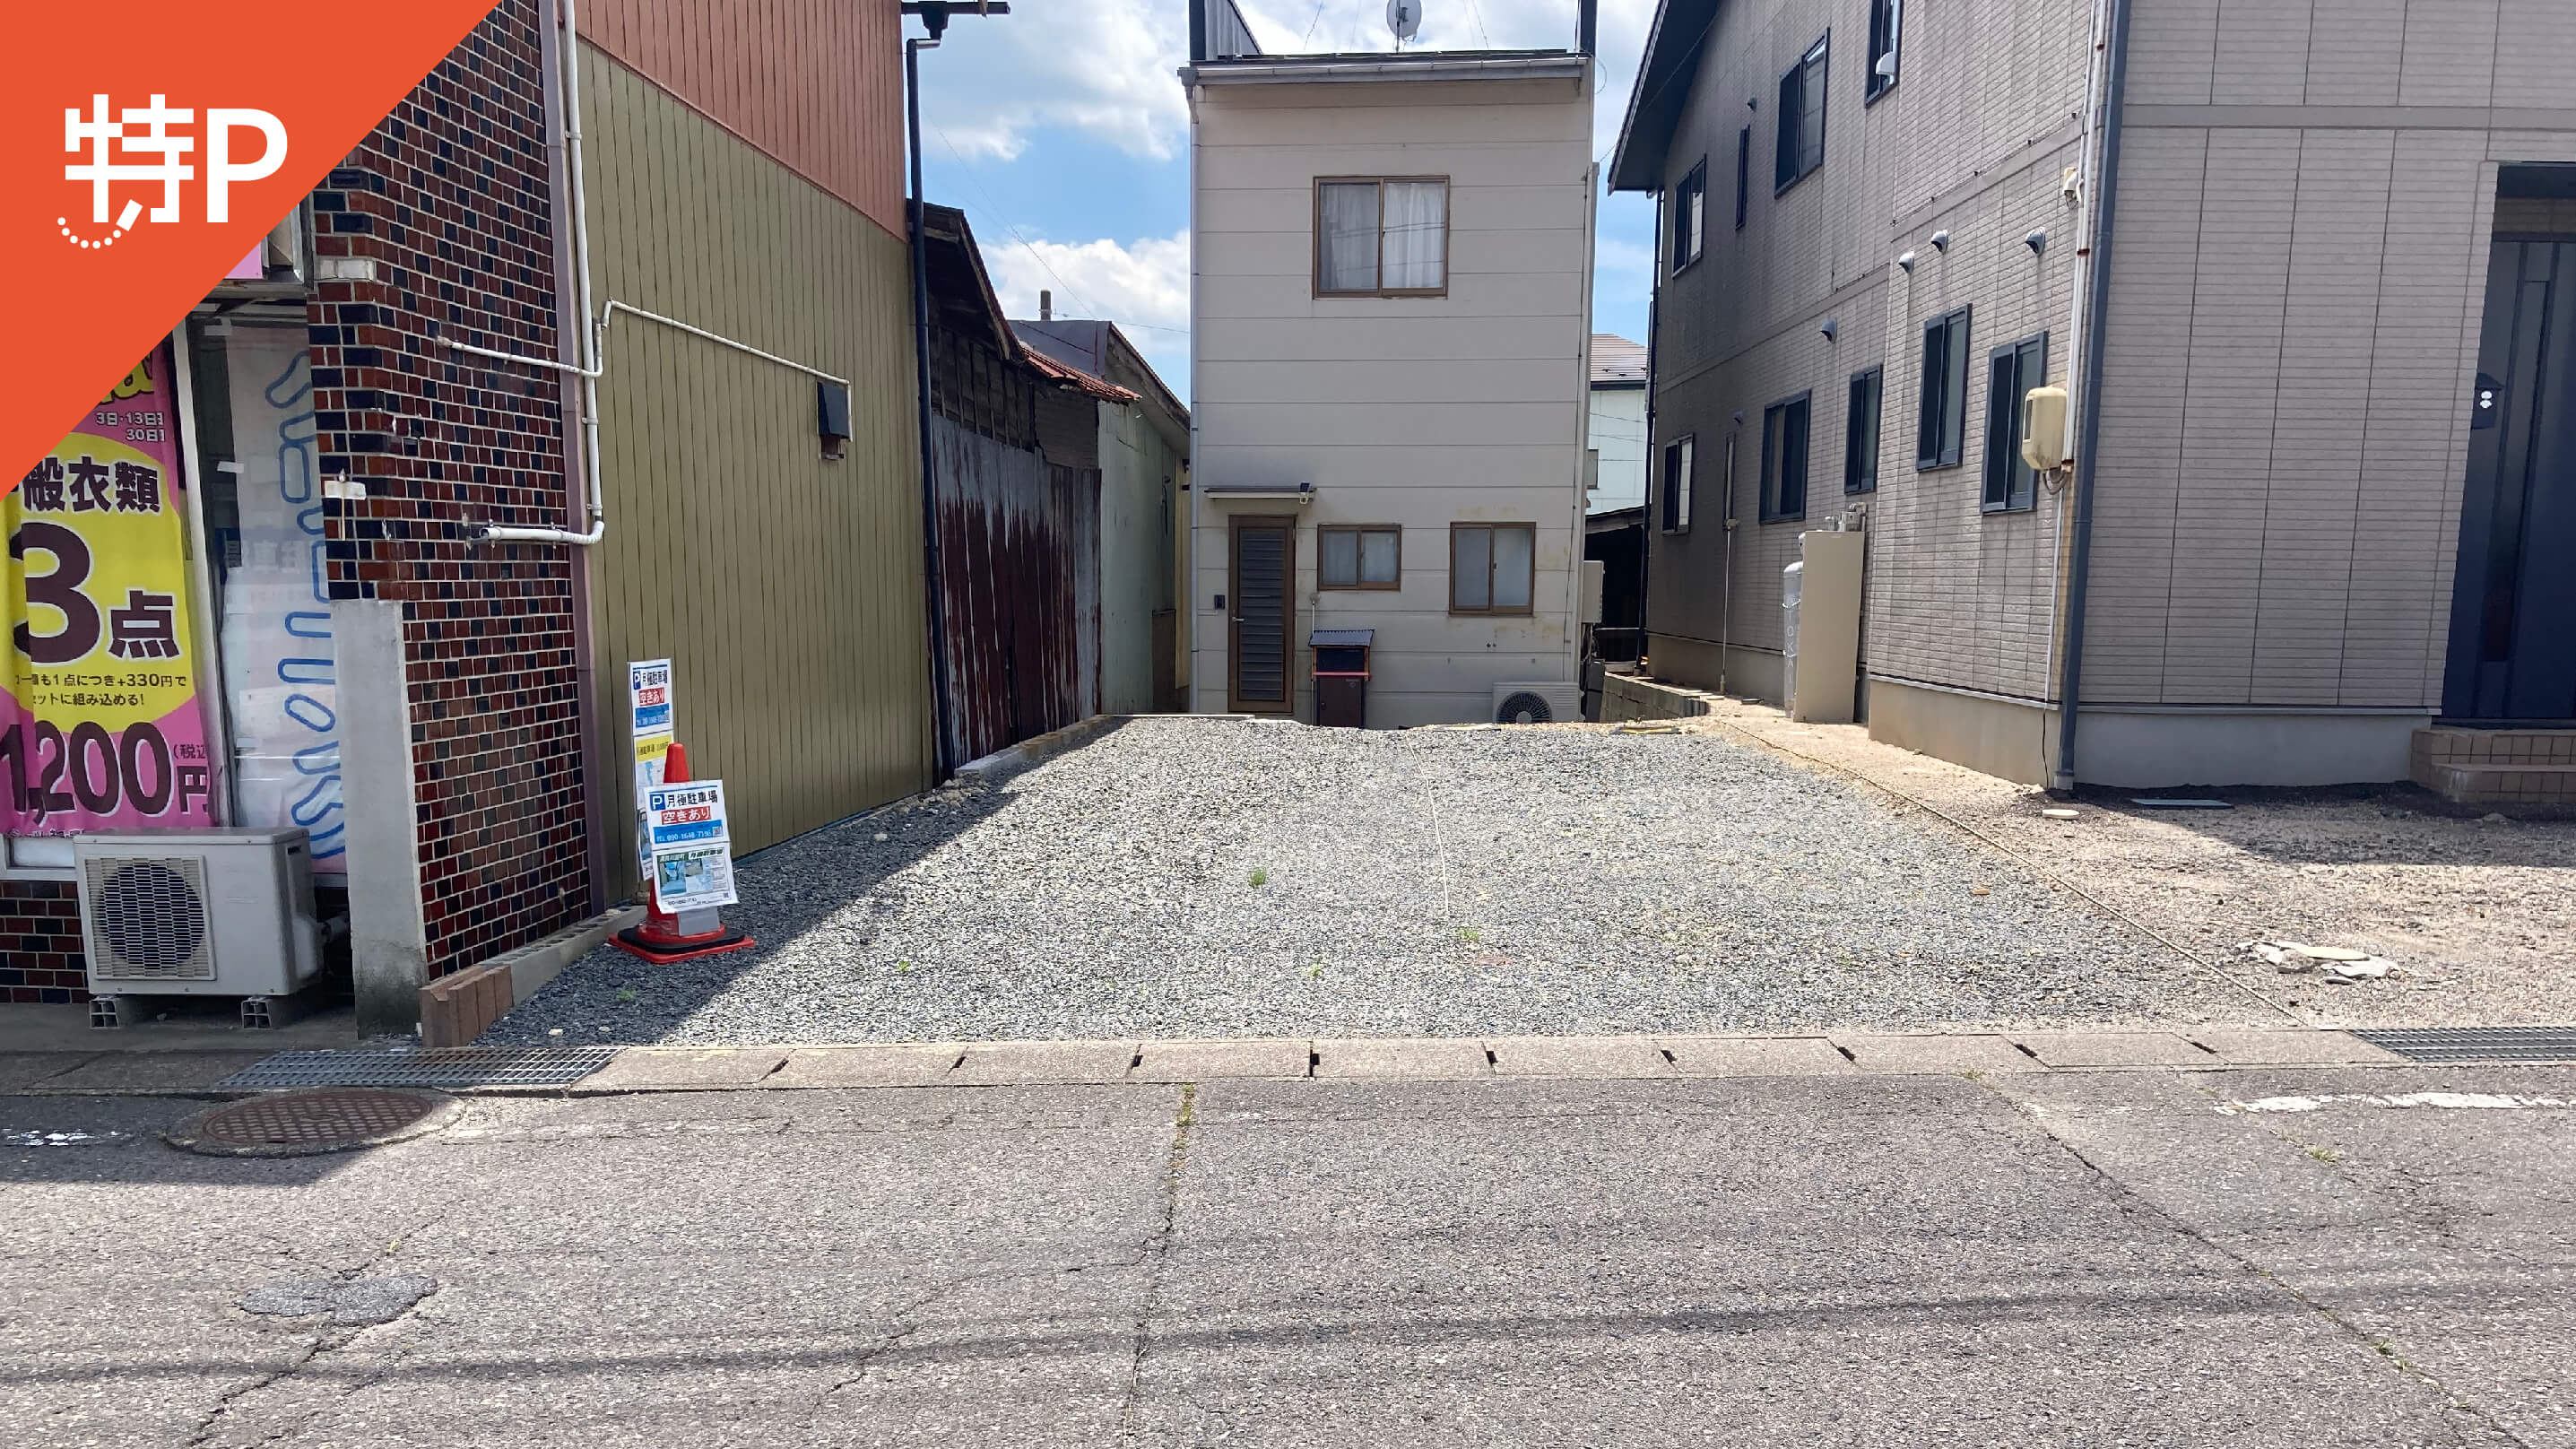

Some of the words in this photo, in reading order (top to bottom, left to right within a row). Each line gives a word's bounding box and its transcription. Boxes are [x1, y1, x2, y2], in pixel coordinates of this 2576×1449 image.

[10, 456, 161, 513] 般衣類
[639, 688, 664, 705] 空きあり
[667, 790, 718, 808] 月極駐車場
[663, 807, 710, 824] 空きあり
